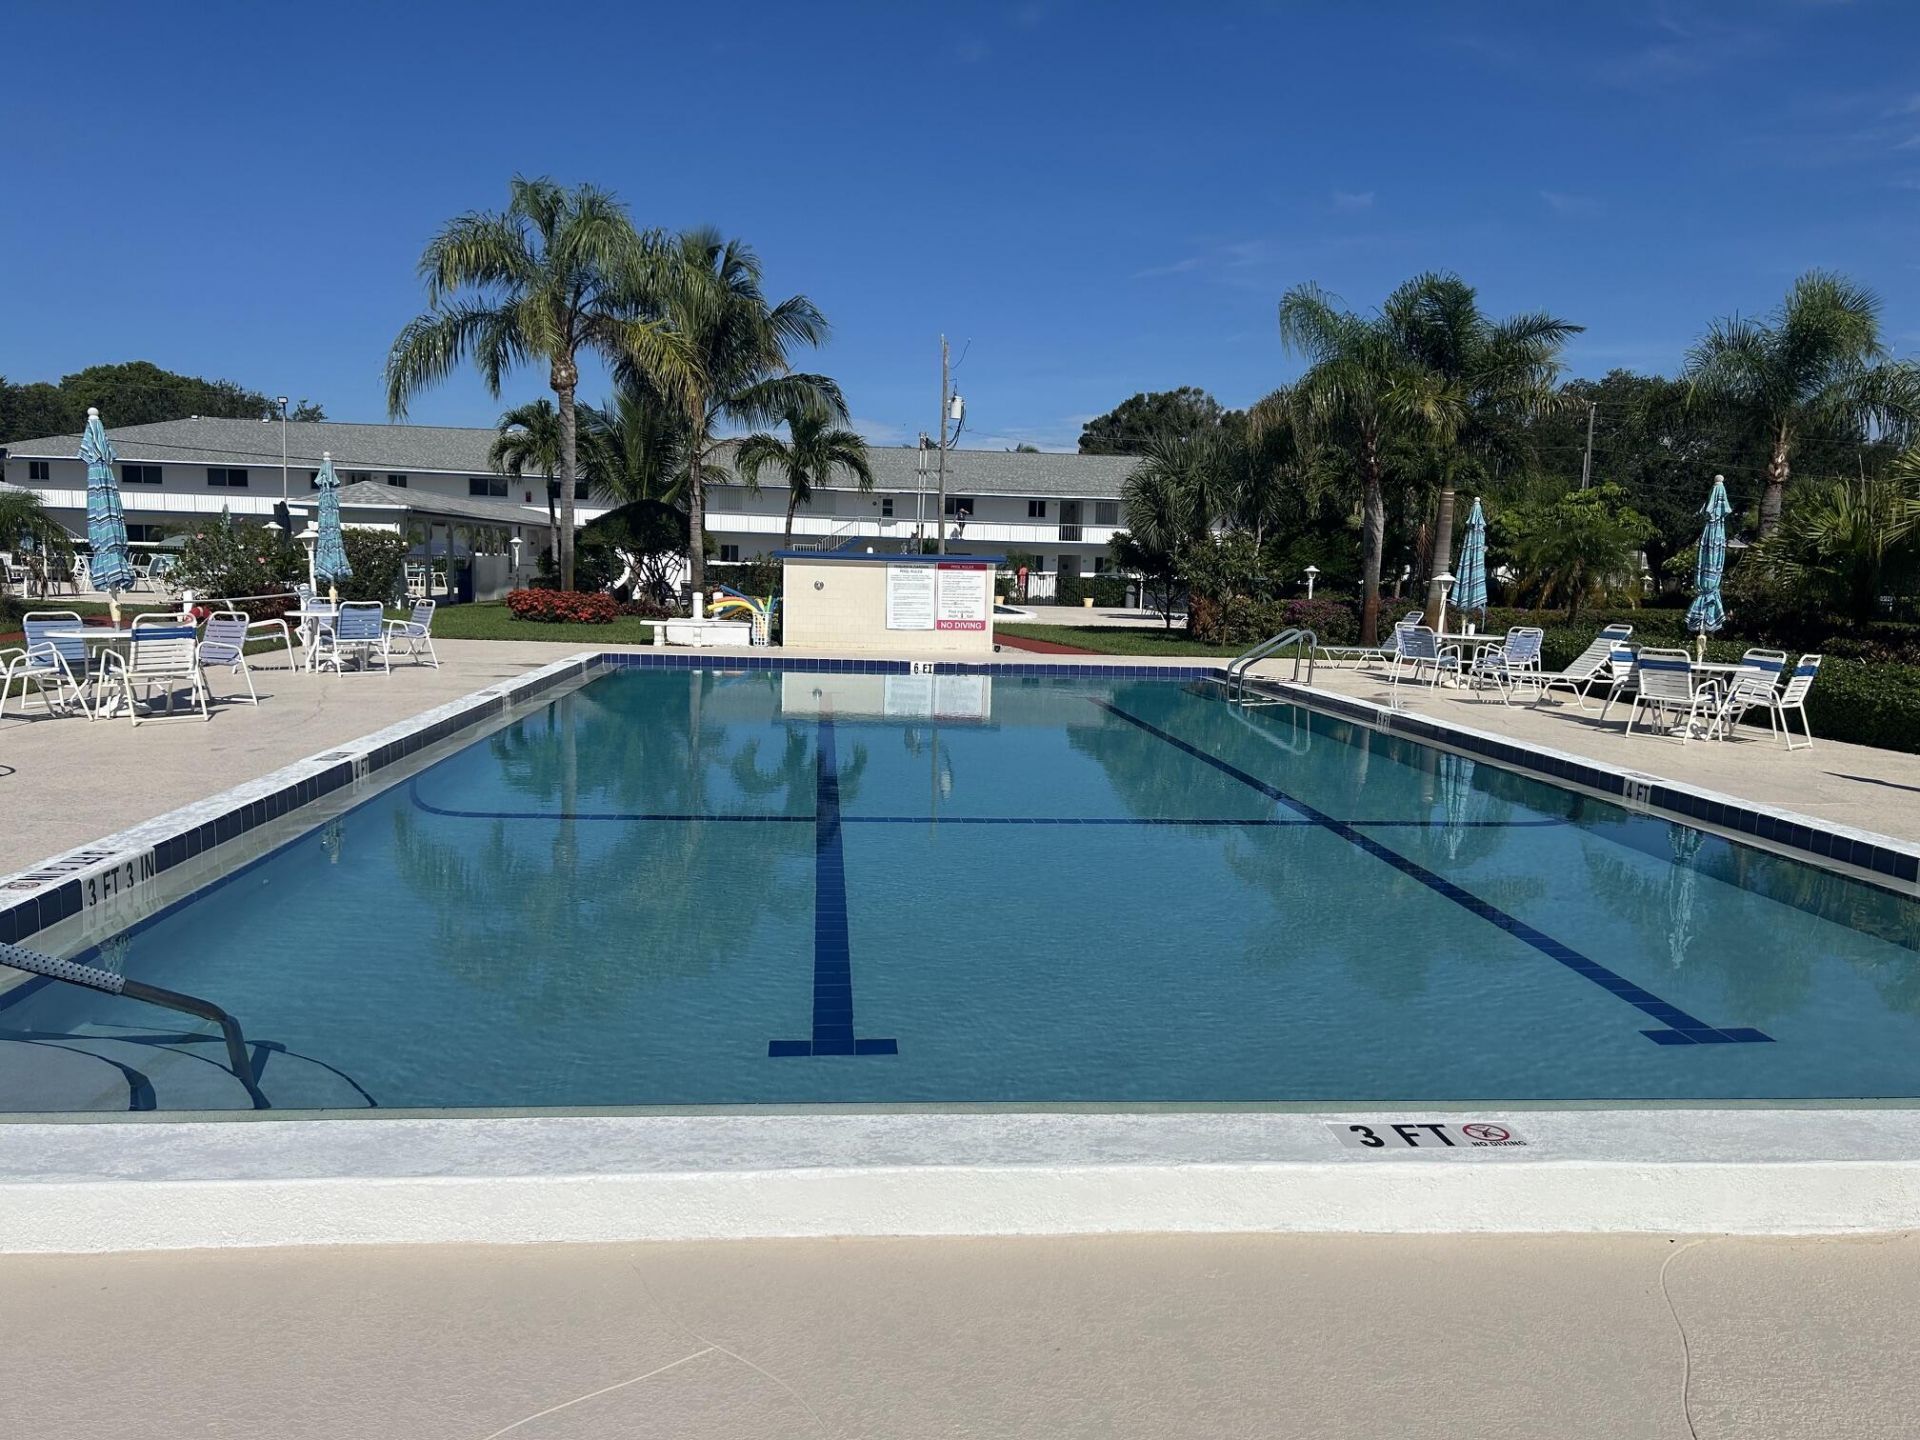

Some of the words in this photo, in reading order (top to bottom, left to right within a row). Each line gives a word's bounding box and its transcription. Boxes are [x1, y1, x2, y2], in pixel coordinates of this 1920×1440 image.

[954, 622, 982, 630] DIVING
[1636, 783, 1650, 803] FT
[88, 878, 97, 906] 3
[103, 867, 119, 899] FT
[126, 862, 135, 889] 3
[140, 851, 155, 882] IN
[1349, 1124, 1385, 1148] 3
[1390, 1123, 1456, 1147] FT
